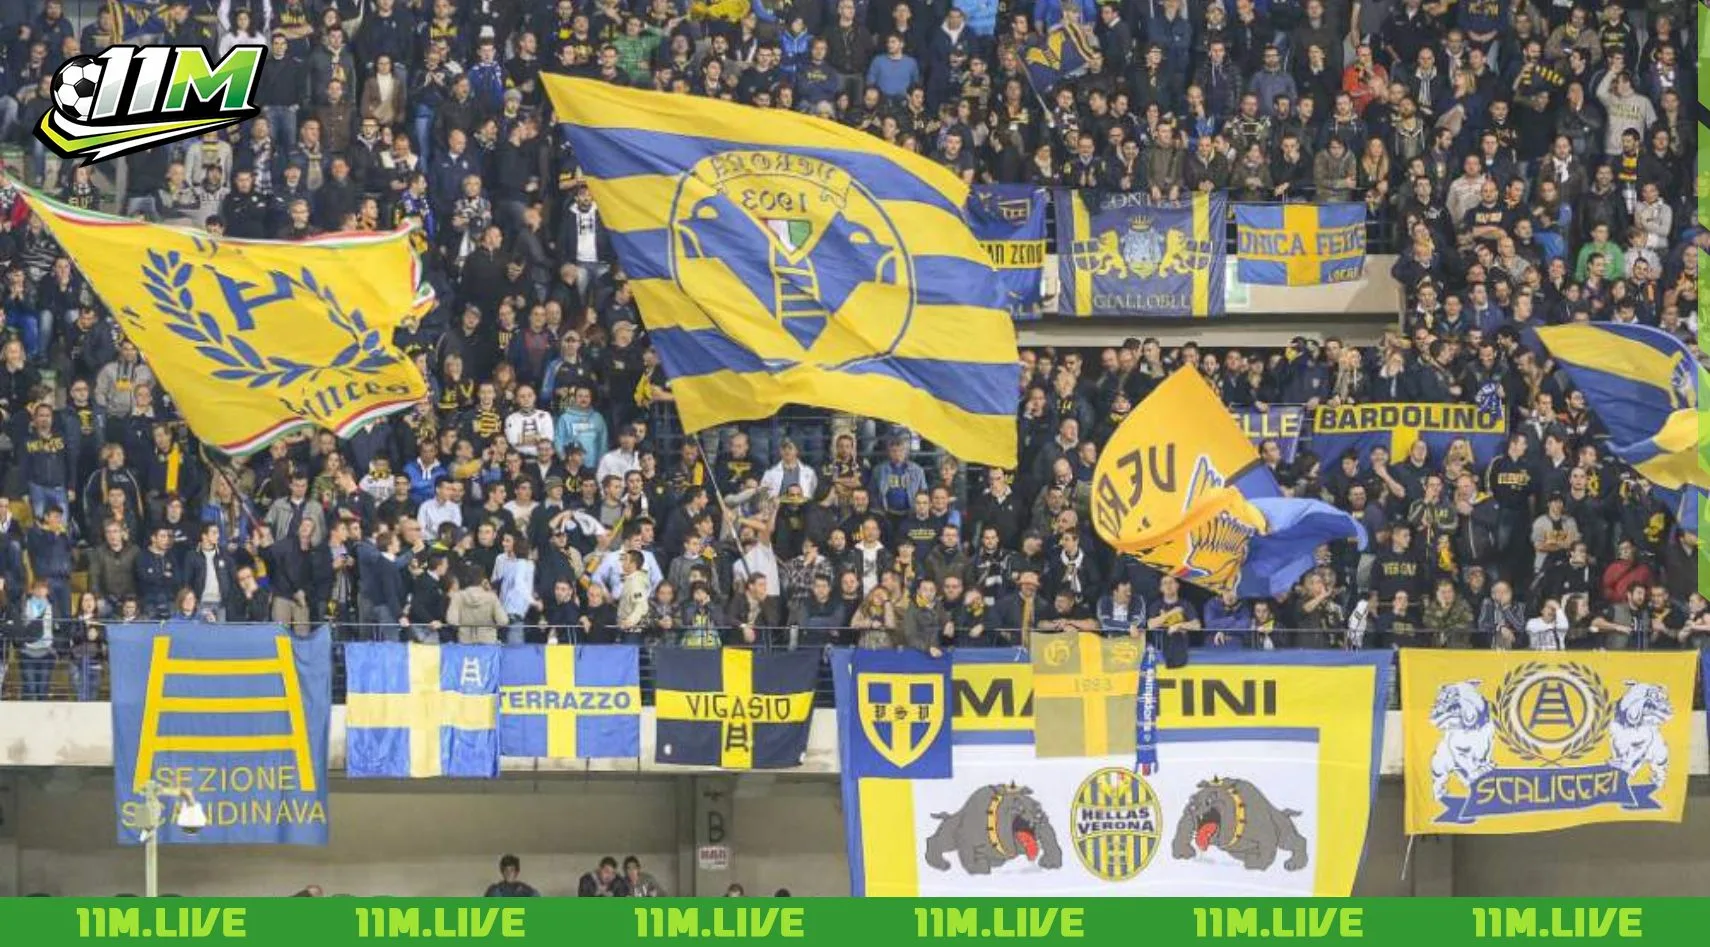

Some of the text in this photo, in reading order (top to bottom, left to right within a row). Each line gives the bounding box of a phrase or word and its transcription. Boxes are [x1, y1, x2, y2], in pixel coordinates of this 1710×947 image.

[1319, 406, 1498, 430] BARDOLINO
[499, 690, 632, 710] TERRAZZO
[685, 694, 790, 721] VIGASIO
[952, 678, 1277, 717] MINI
[156, 766, 296, 792] SEZIONE
[121, 800, 327, 828] SDINAVA
[1081, 807, 1150, 821] HELLAS
[1077, 820, 1155, 835] VERONA
